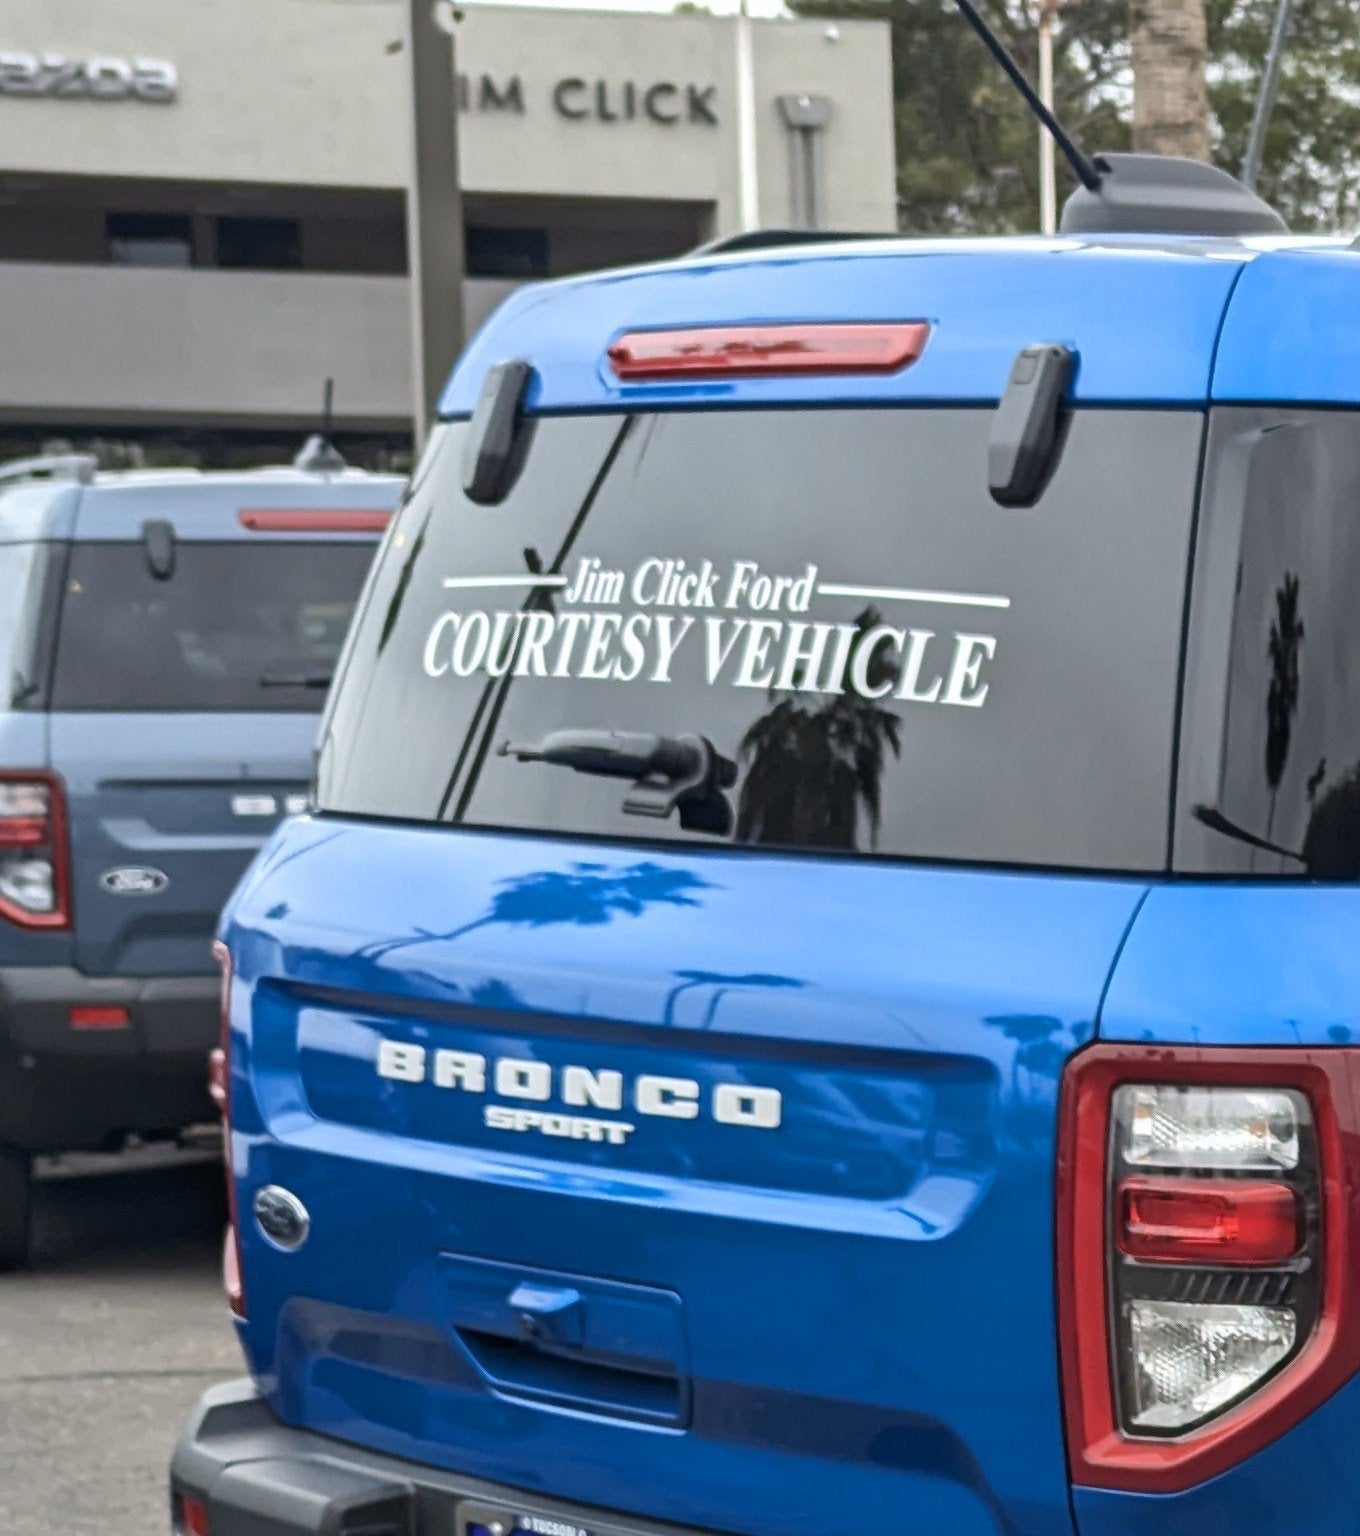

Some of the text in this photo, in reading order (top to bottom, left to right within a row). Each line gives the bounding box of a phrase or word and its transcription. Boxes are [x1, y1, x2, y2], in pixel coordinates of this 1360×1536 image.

[456, 72, 719, 126] IM CLICK
[563, 557, 819, 613] Jim Click Ford
[422, 610, 998, 709] COURTESY VEHICLE
[376, 1040, 783, 1130] BRONCO
[484, 1104, 636, 1146] SPORT
